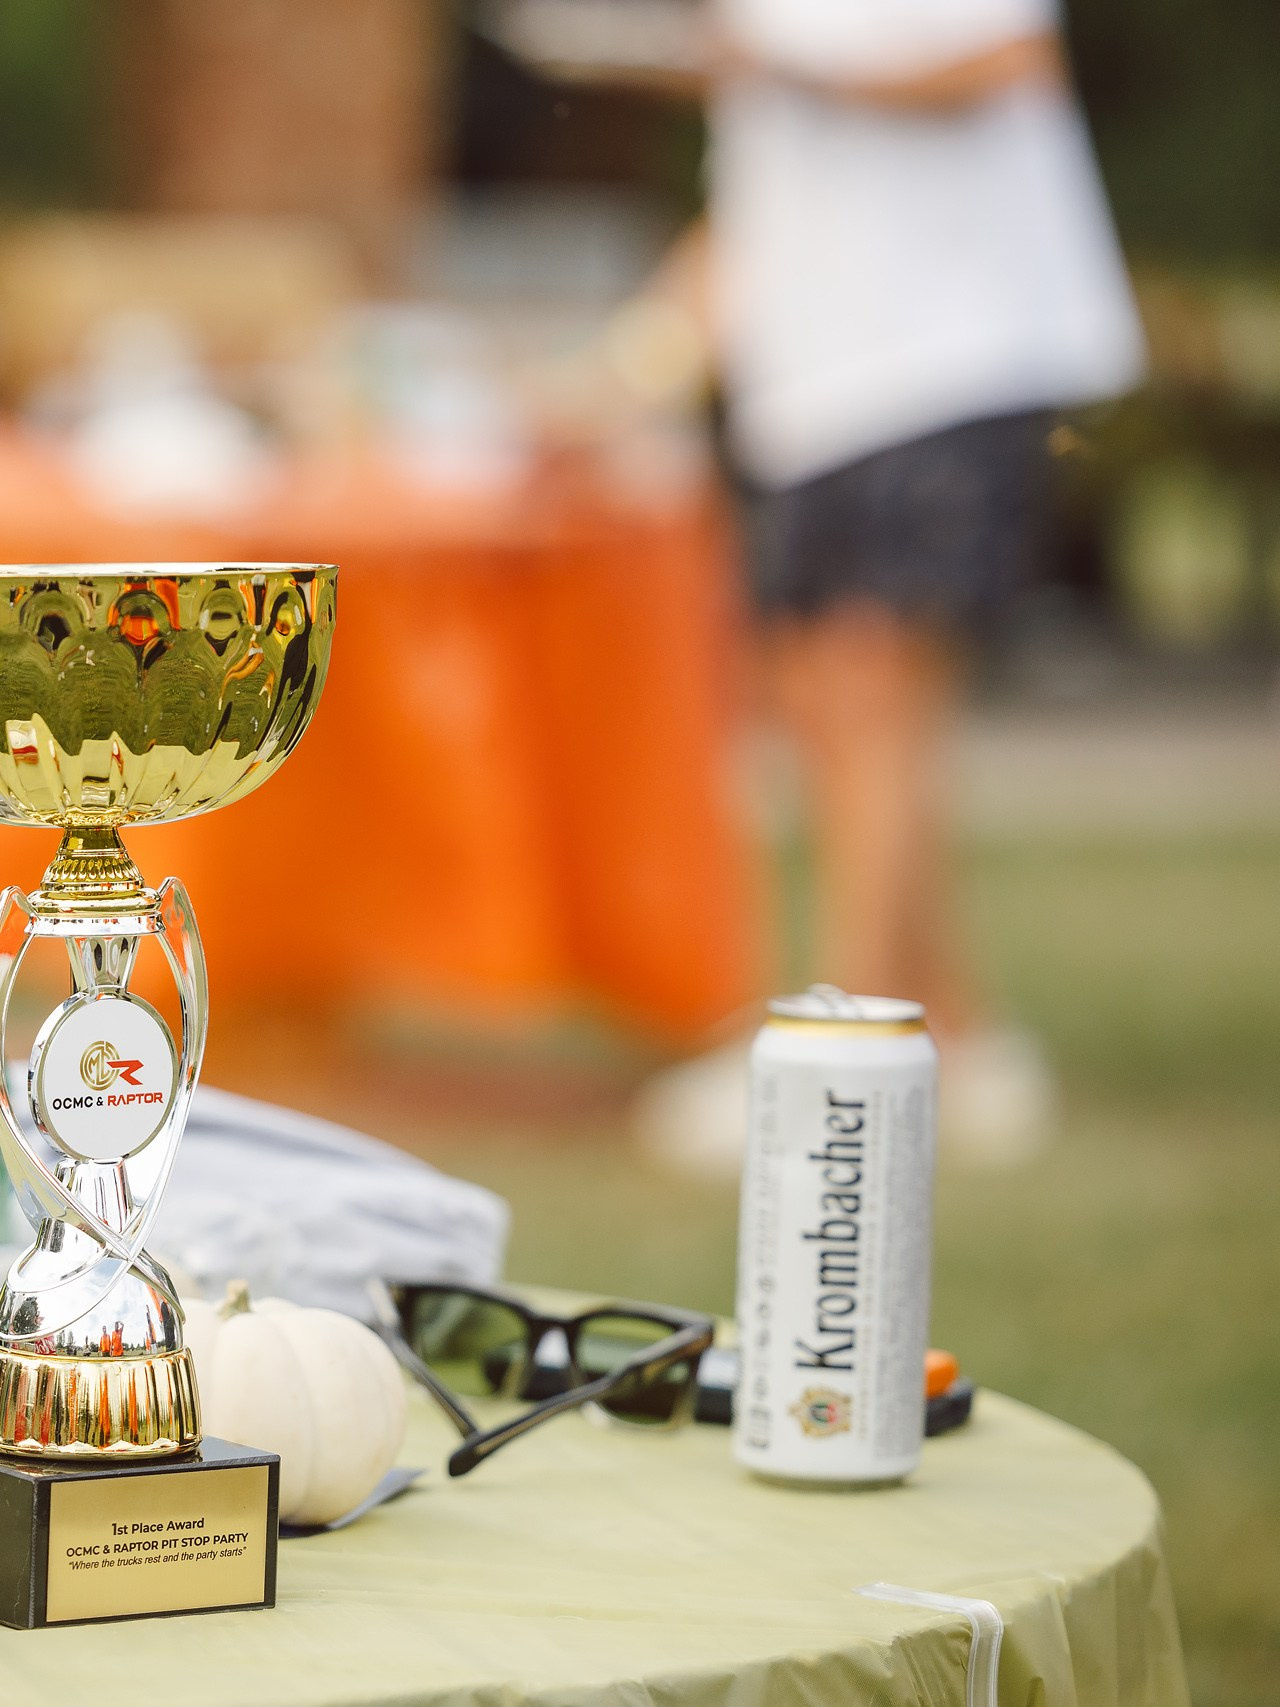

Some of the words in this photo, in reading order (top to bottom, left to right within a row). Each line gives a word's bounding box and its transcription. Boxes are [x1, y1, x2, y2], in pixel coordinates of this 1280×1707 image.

[53, 1096, 93, 1110] OCMC
[96, 1096, 104, 1106] &
[107, 1092, 164, 1107] RAPTOR
[794, 1088, 865, 1372] Krombacher
[111, 1523, 128, 1535] 1st
[131, 1522, 164, 1534] Place
[166, 1517, 204, 1531] Award
[66, 1545, 100, 1557] OCMC
[103, 1545, 110, 1554] &
[113, 1541, 159, 1553] RAPTOR
[161, 1538, 179, 1549] PIT
[181, 1536, 210, 1547] STOP
[213, 1532, 249, 1544] PARTY
[101, 1558, 115, 1568] the
[117, 1556, 143, 1567] trucks
[144, 1555, 161, 1564] rest
[162, 1552, 179, 1563] and
[180, 1551, 194, 1561] the
[195, 1549, 218, 1562] party
